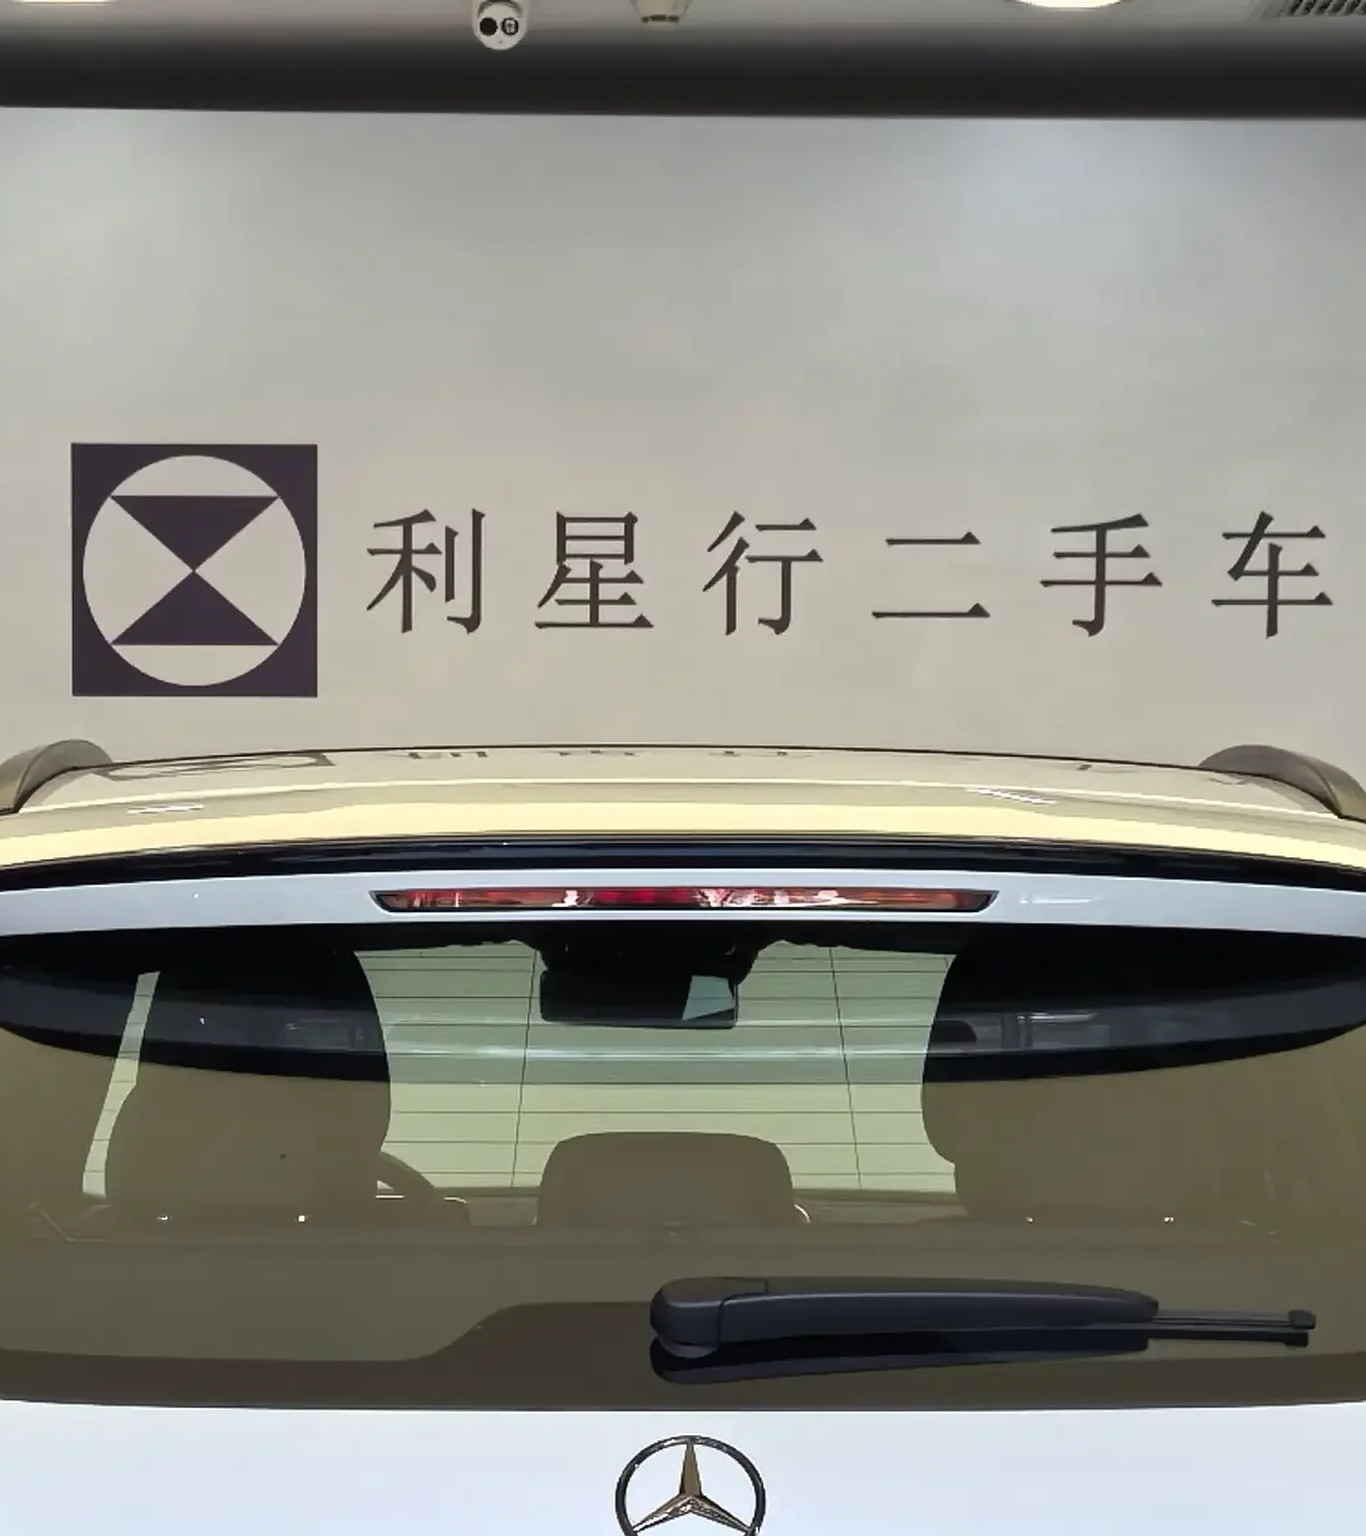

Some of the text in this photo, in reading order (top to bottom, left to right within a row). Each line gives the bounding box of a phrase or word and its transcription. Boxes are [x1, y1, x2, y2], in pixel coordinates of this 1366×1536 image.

[366, 507, 1334, 638] 利星行二手车
